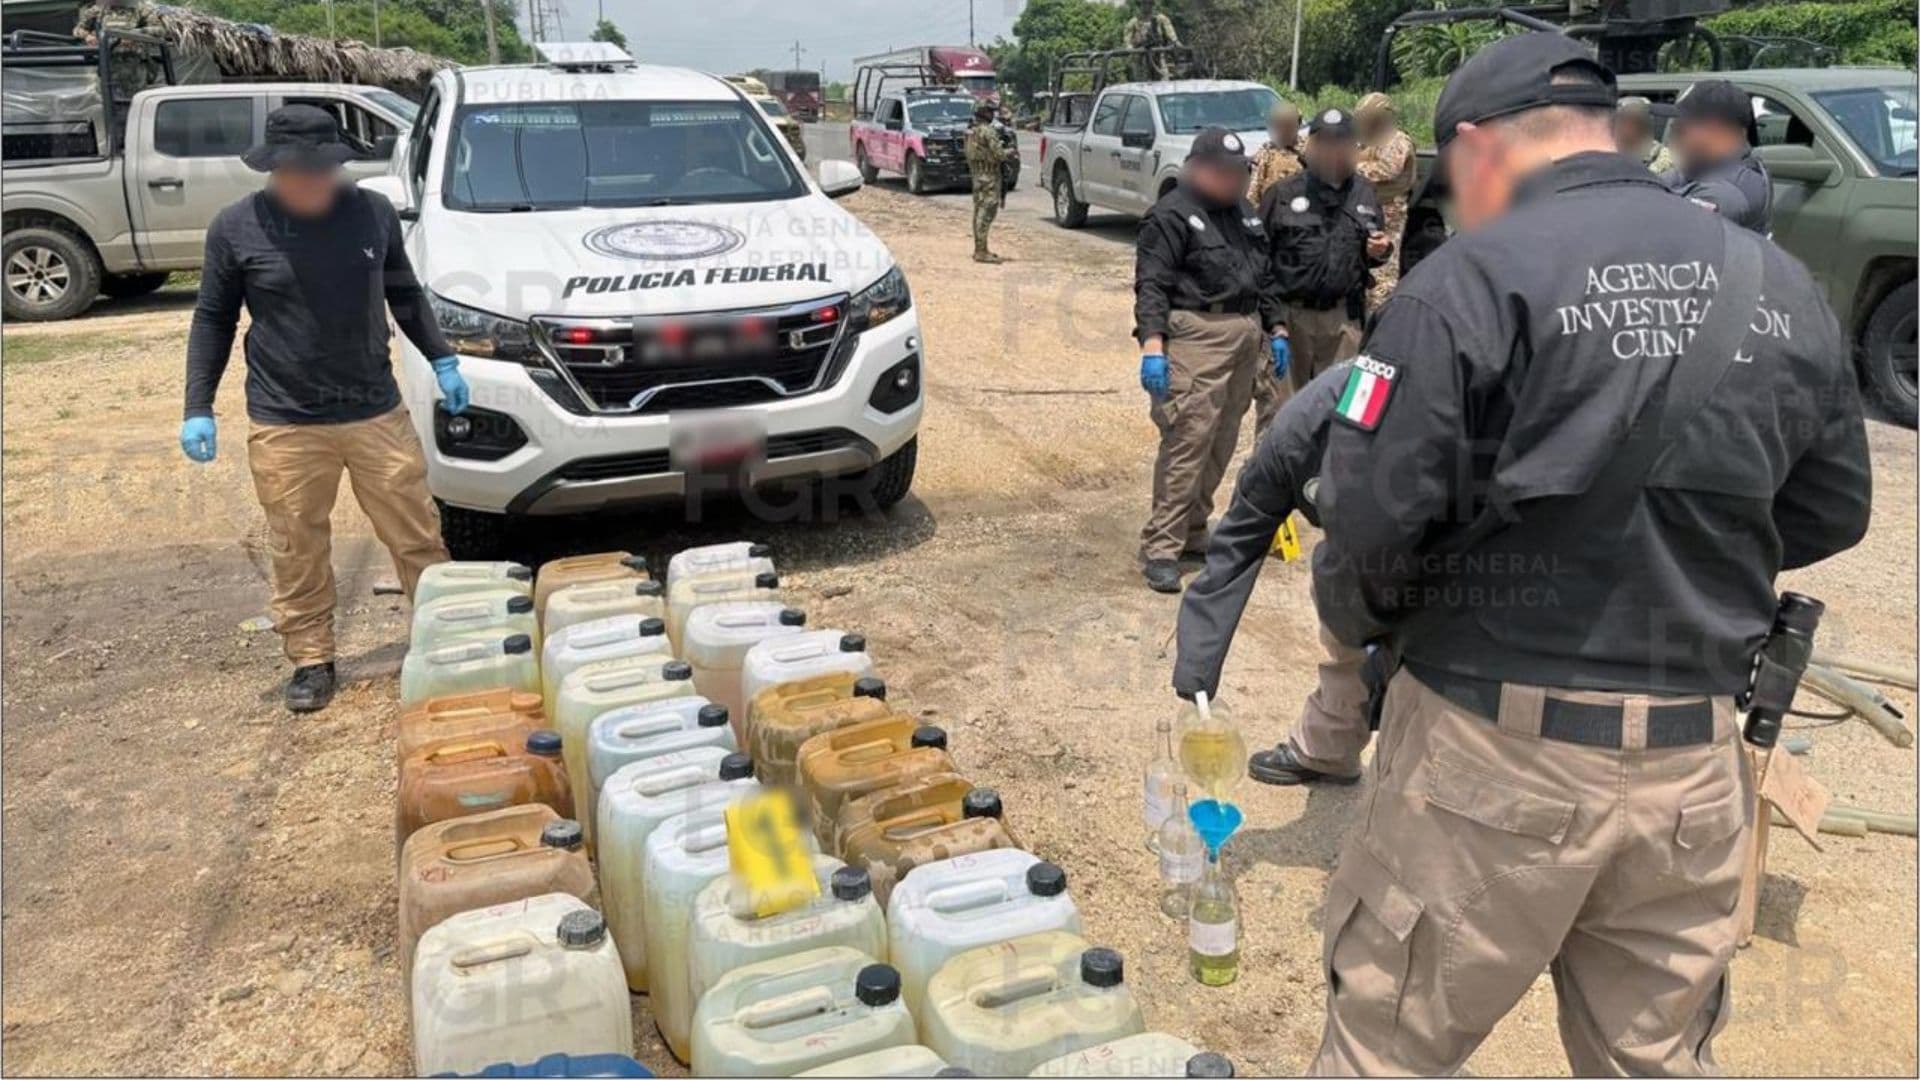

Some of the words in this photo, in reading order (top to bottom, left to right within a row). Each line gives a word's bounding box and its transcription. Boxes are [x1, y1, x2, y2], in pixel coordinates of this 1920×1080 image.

[562, 268, 697, 299] POLICIA
[704, 262, 833, 292] FEDERAL
[1585, 261, 1720, 294] AGENCIA
